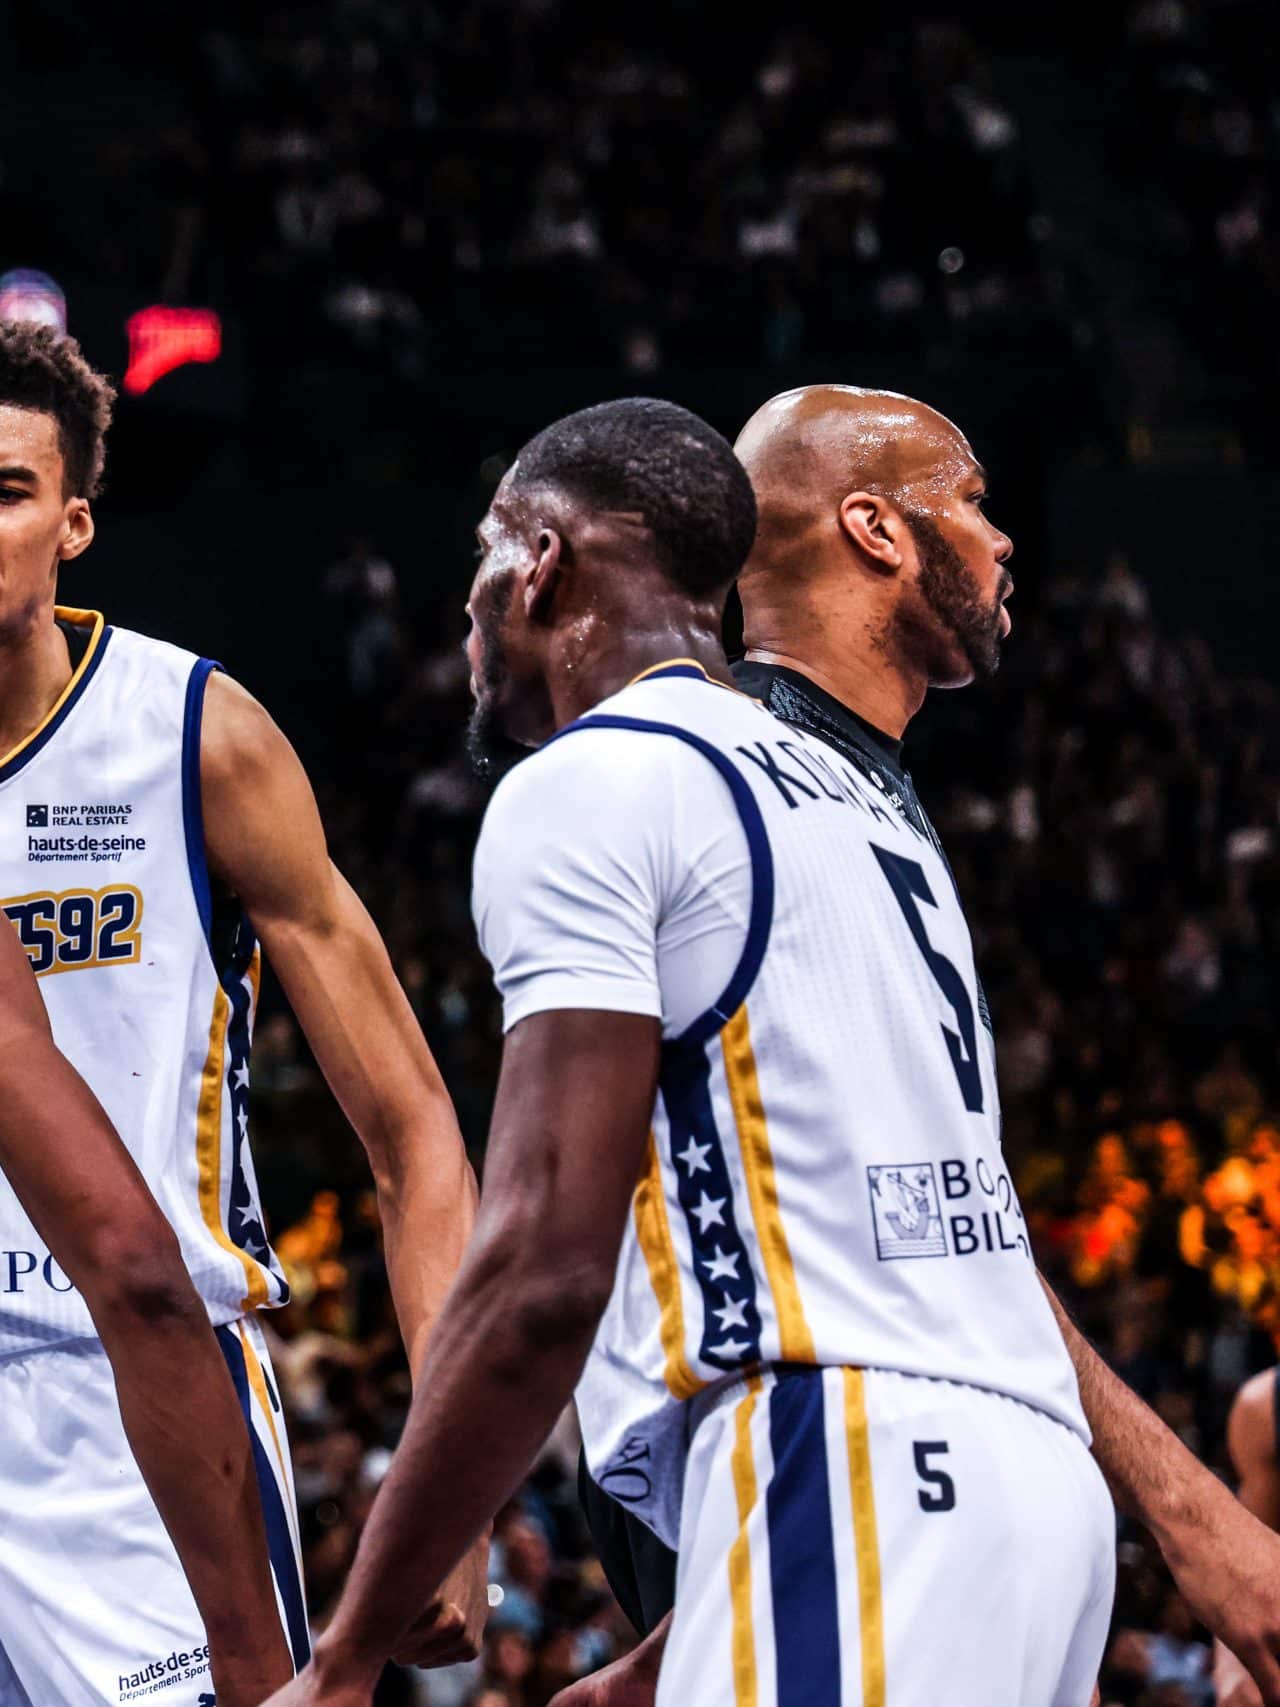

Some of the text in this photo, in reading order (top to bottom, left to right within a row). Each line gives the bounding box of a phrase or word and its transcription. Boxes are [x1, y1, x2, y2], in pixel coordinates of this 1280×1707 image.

[52, 804, 133, 815] BNP PARIBAS
[52, 815, 129, 826] REAL ESTATE
[28, 852, 123, 863] Département Sportif
[867, 840, 986, 1115] 5
[912, 1439, 957, 1513] 5
